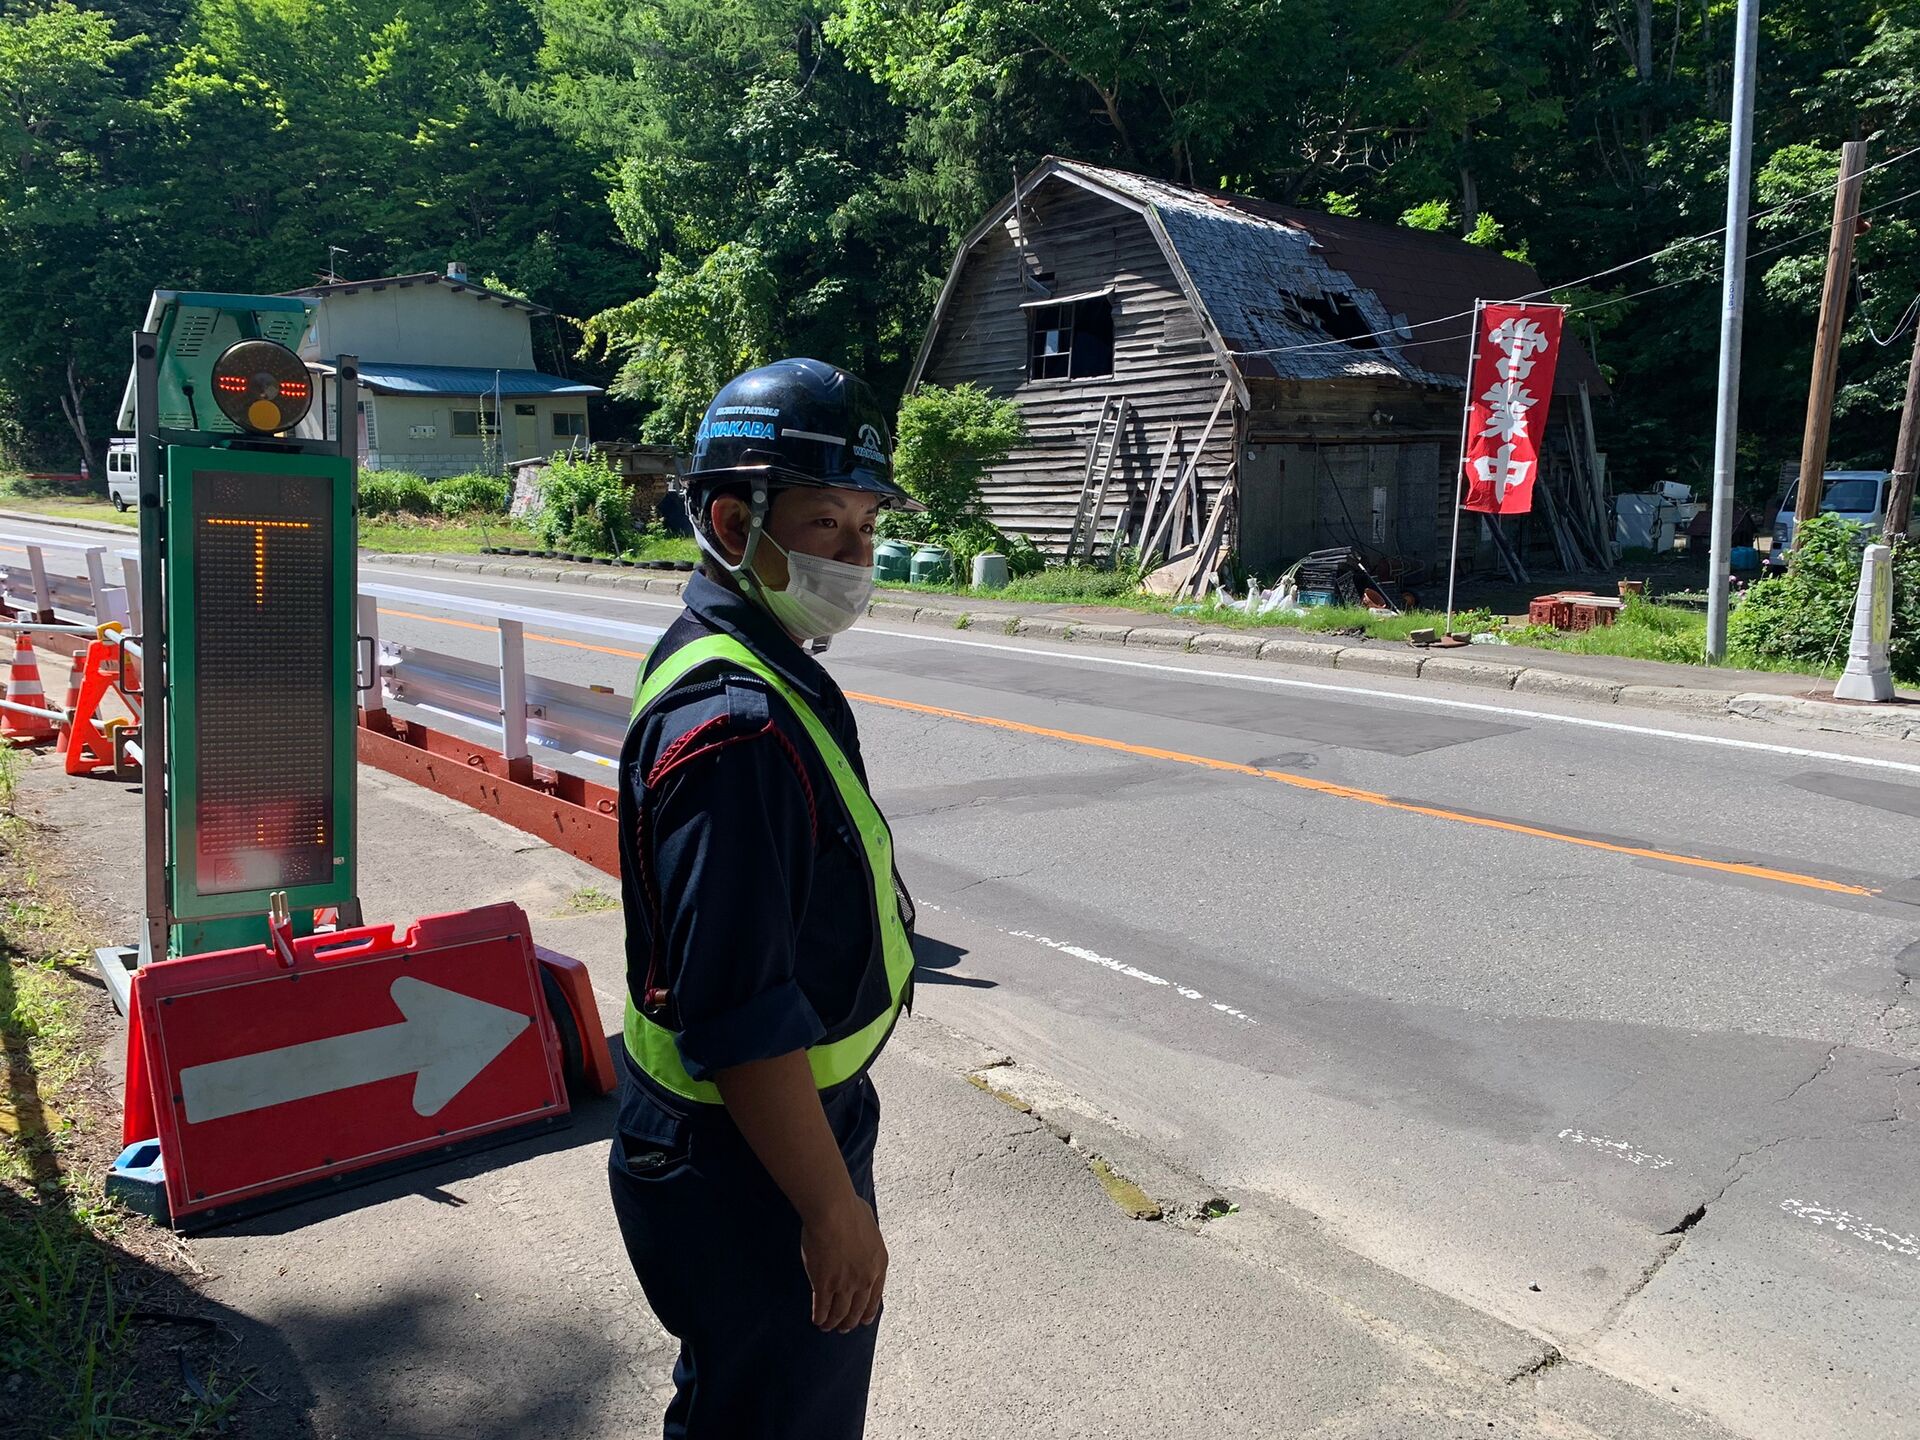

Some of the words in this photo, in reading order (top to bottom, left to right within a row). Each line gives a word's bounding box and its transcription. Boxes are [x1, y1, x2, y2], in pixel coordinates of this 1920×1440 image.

[1473, 317, 1549, 505] 営業中
[709, 420, 776, 440] WAKABA
[853, 445, 886, 465] WAKABA
